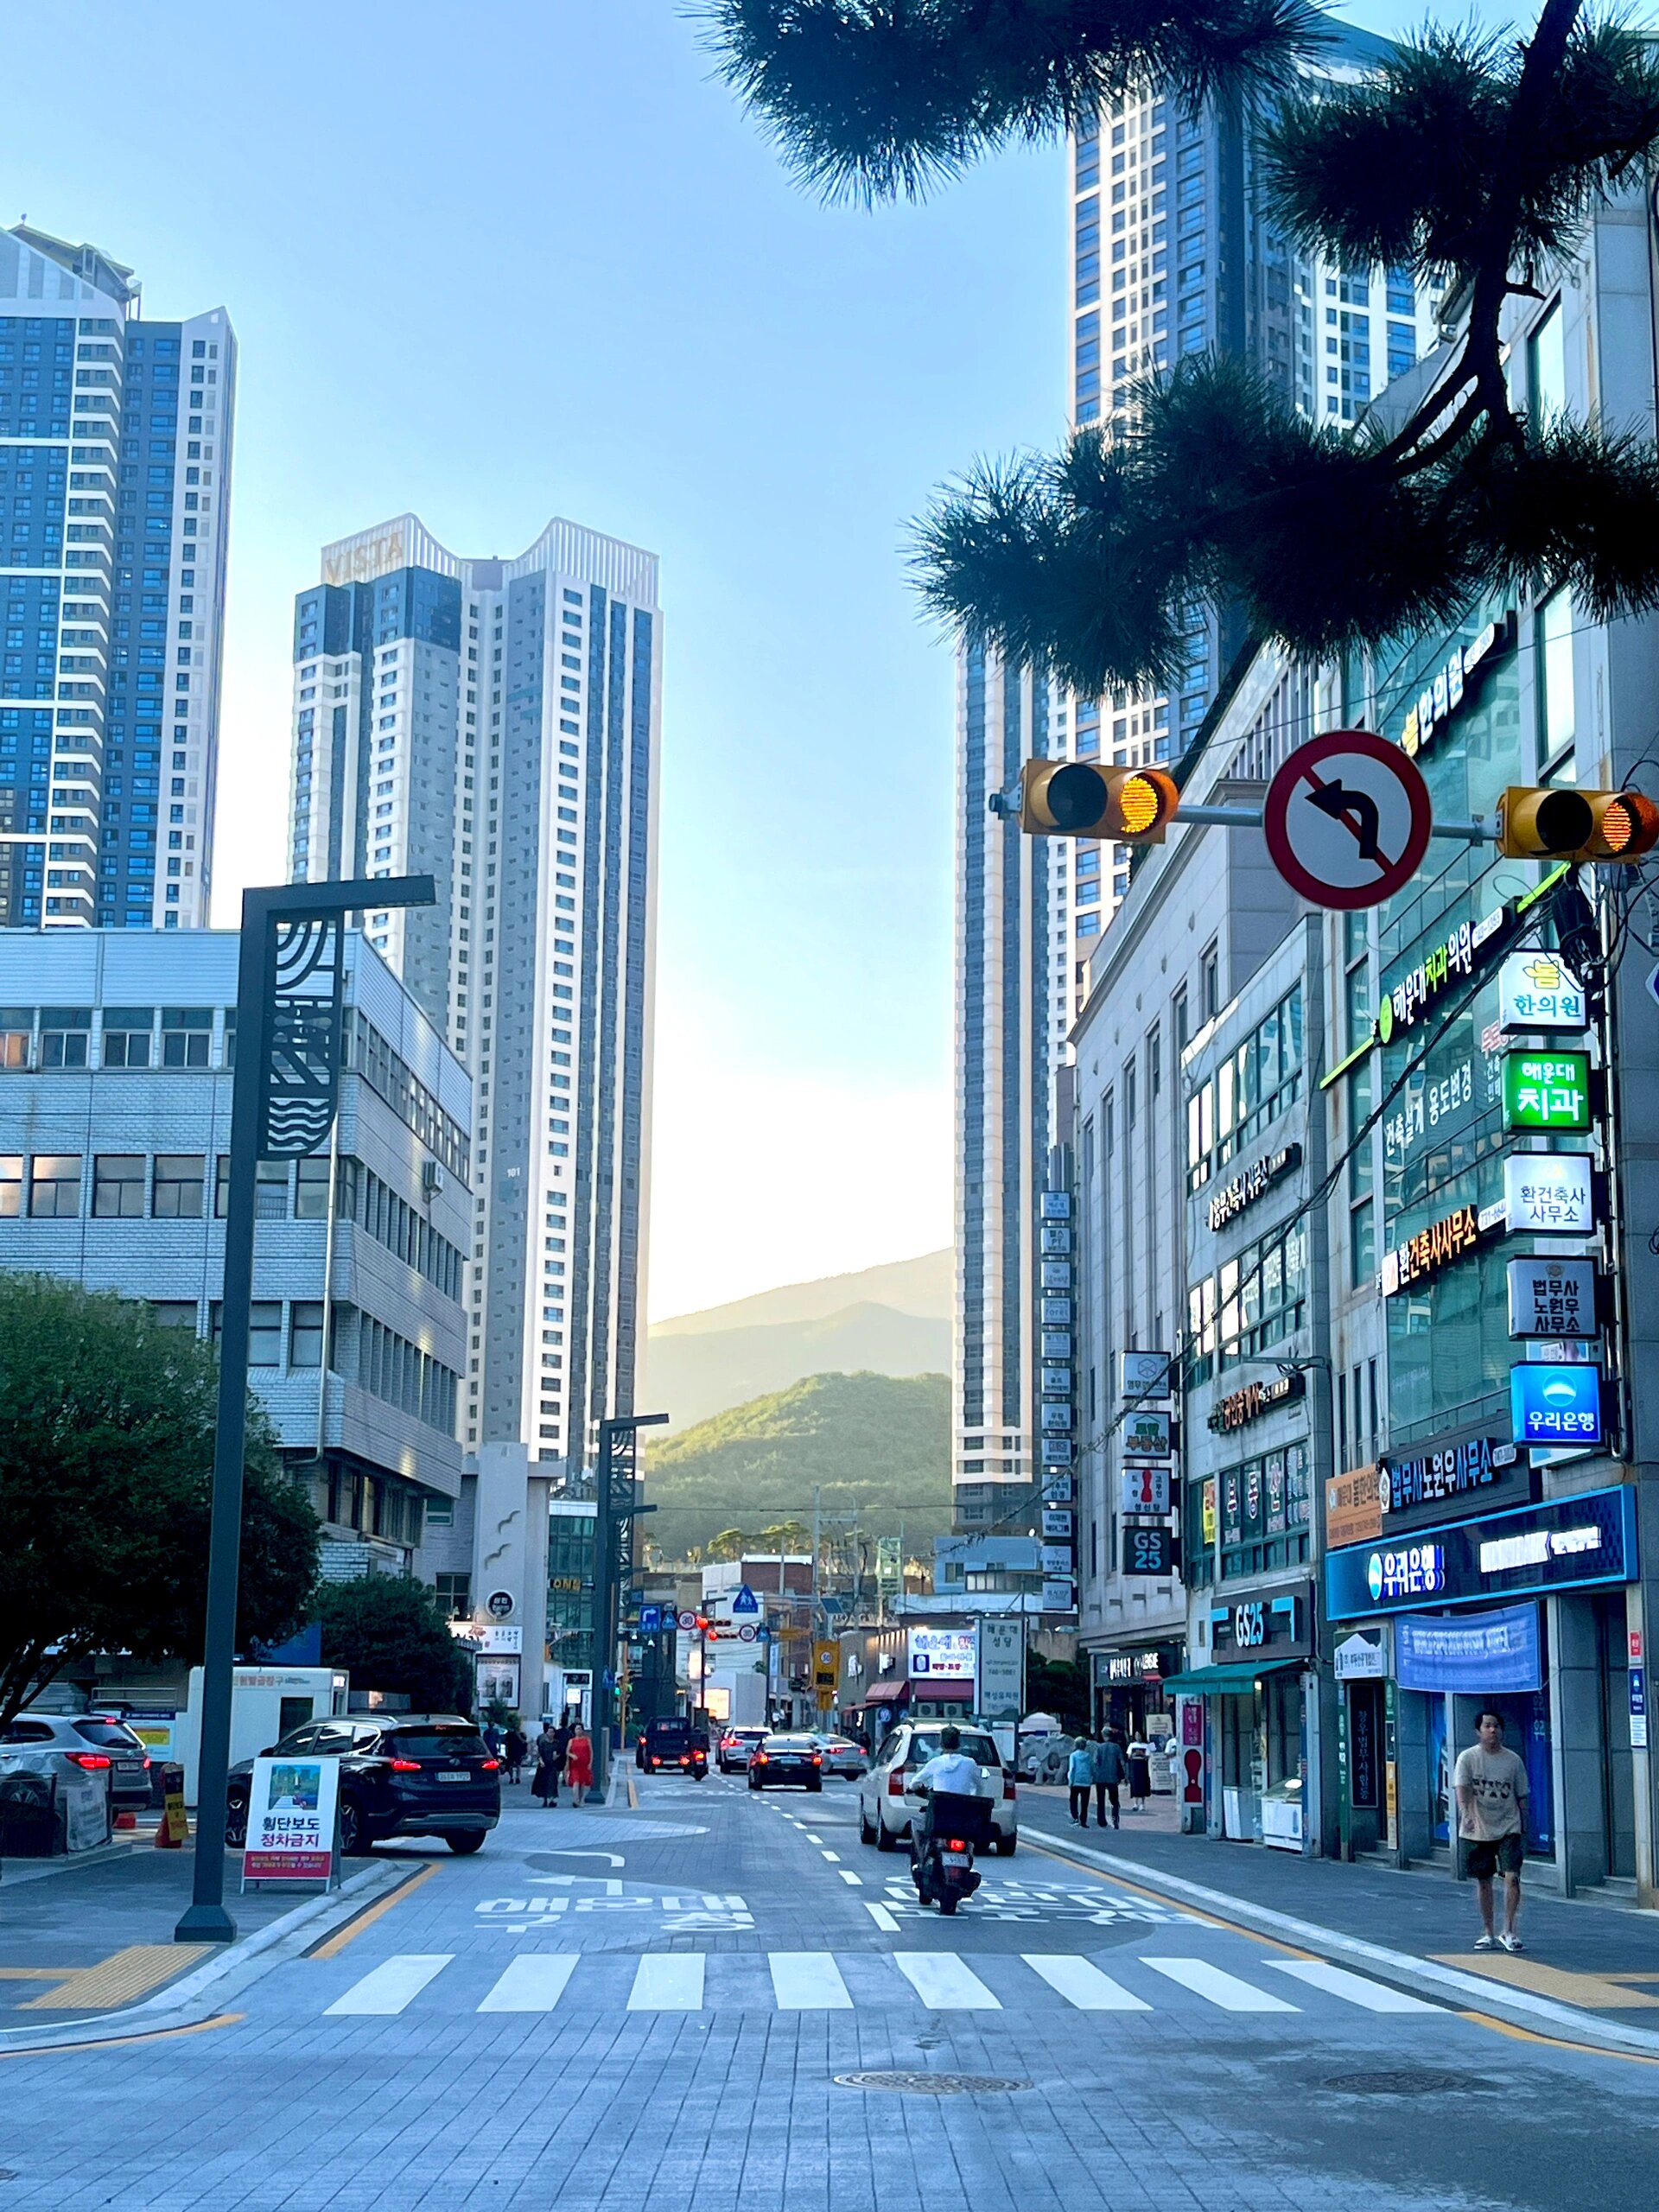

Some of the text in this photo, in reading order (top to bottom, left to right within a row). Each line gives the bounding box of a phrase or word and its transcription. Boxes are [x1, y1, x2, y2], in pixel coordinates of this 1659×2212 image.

[326, 532, 403, 584] VISTA
[1514, 995, 1581, 1018] 한의원
[1522, 1062, 1575, 1084] 해운대
[1429, 1059, 1471, 1126] 용도변경
[1518, 1088, 1584, 1121] 치과
[1520, 1185, 1586, 1205] 환건축사
[1529, 1205, 1580, 1224] 사무소
[1398, 1205, 1476, 1285] 환건축사사무소
[1533, 1279, 1580, 1297] 법무사
[1534, 1298, 1580, 1314] 노원우
[1535, 1316, 1580, 1333] 사무소
[1528, 1411, 1595, 1433] 우리은행
[1133, 1531, 1162, 1550] GS
[1135, 1550, 1162, 1569] 25
[1383, 1543, 1439, 1597] 우리은행
[1235, 1603, 1265, 1649] GS25
[262, 1816, 321, 1832] 횡단보도
[261, 1833, 319, 1848] 정차금지
[474, 1896, 748, 1913] 해운대
